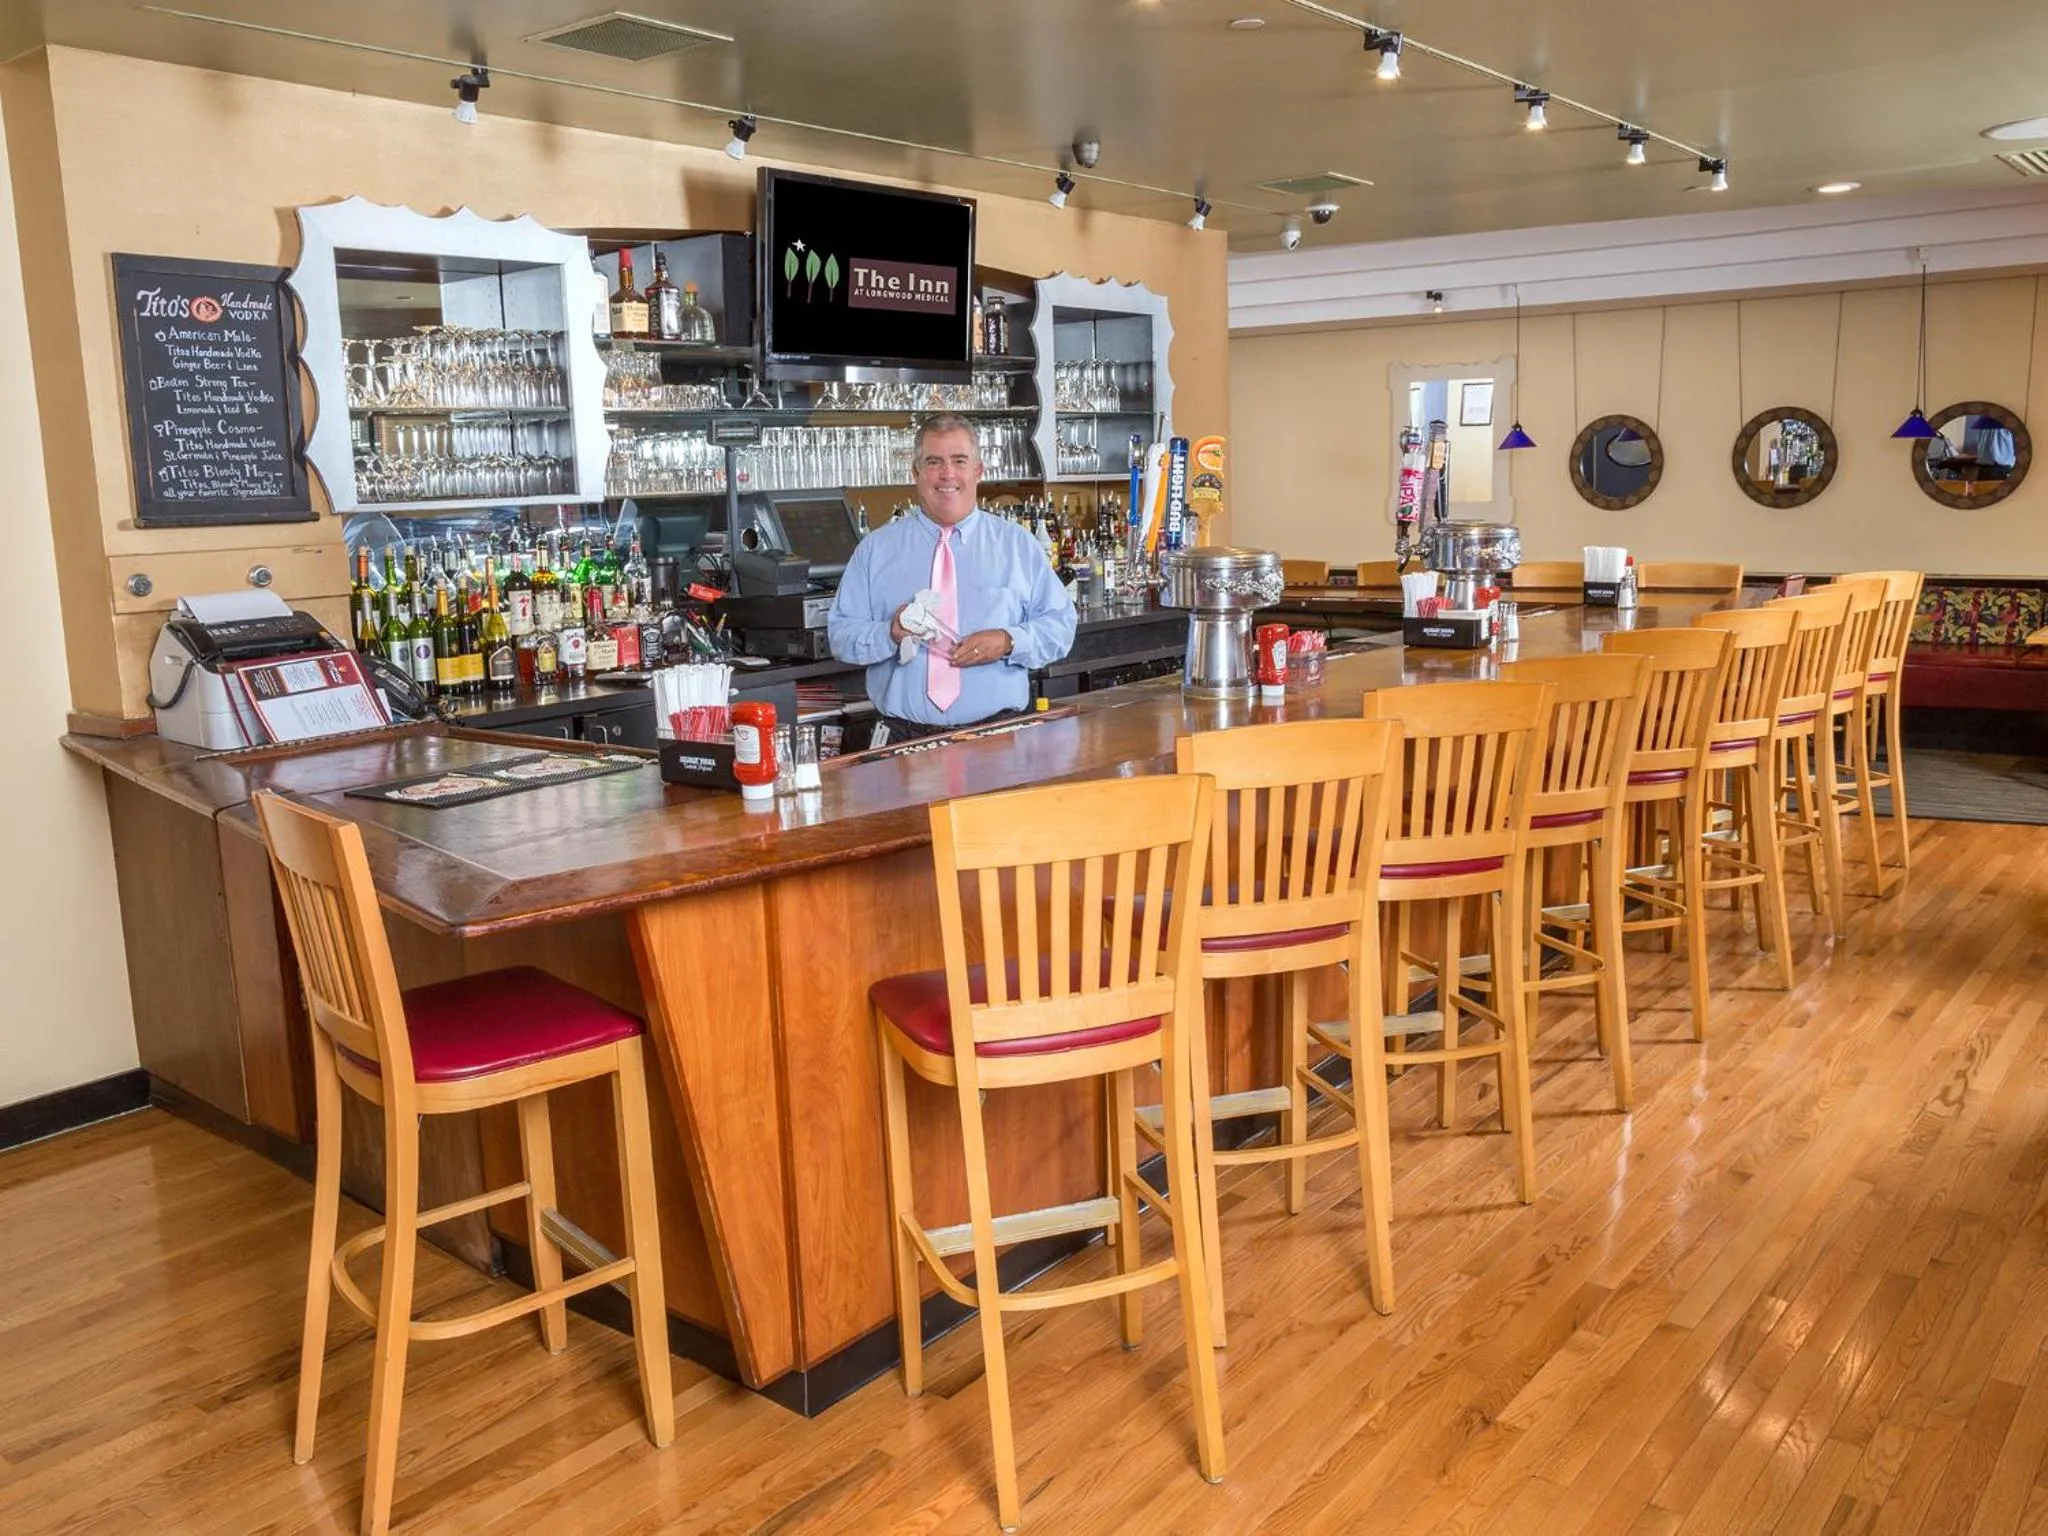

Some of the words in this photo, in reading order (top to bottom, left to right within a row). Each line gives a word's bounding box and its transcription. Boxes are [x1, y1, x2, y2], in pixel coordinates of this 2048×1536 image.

[854, 268, 900, 290] The
[909, 273, 949, 294] Inn
[137, 287, 189, 318] Tito's
[220, 292, 273, 310] Handmade
[854, 288, 864, 296] AT
[866, 289, 913, 300] LONGWOOD
[915, 293, 949, 303] MEDICAL
[229, 310, 268, 321] VODKA
[168, 326, 220, 341] American
[204, 357, 226, 369] Beer
[195, 374, 227, 391] Strong
[164, 420, 212, 439] Pineapple
[203, 463, 241, 482] Bloody
[1171, 454, 1185, 499] LIGHT
[1170, 500, 1182, 532] BUD
